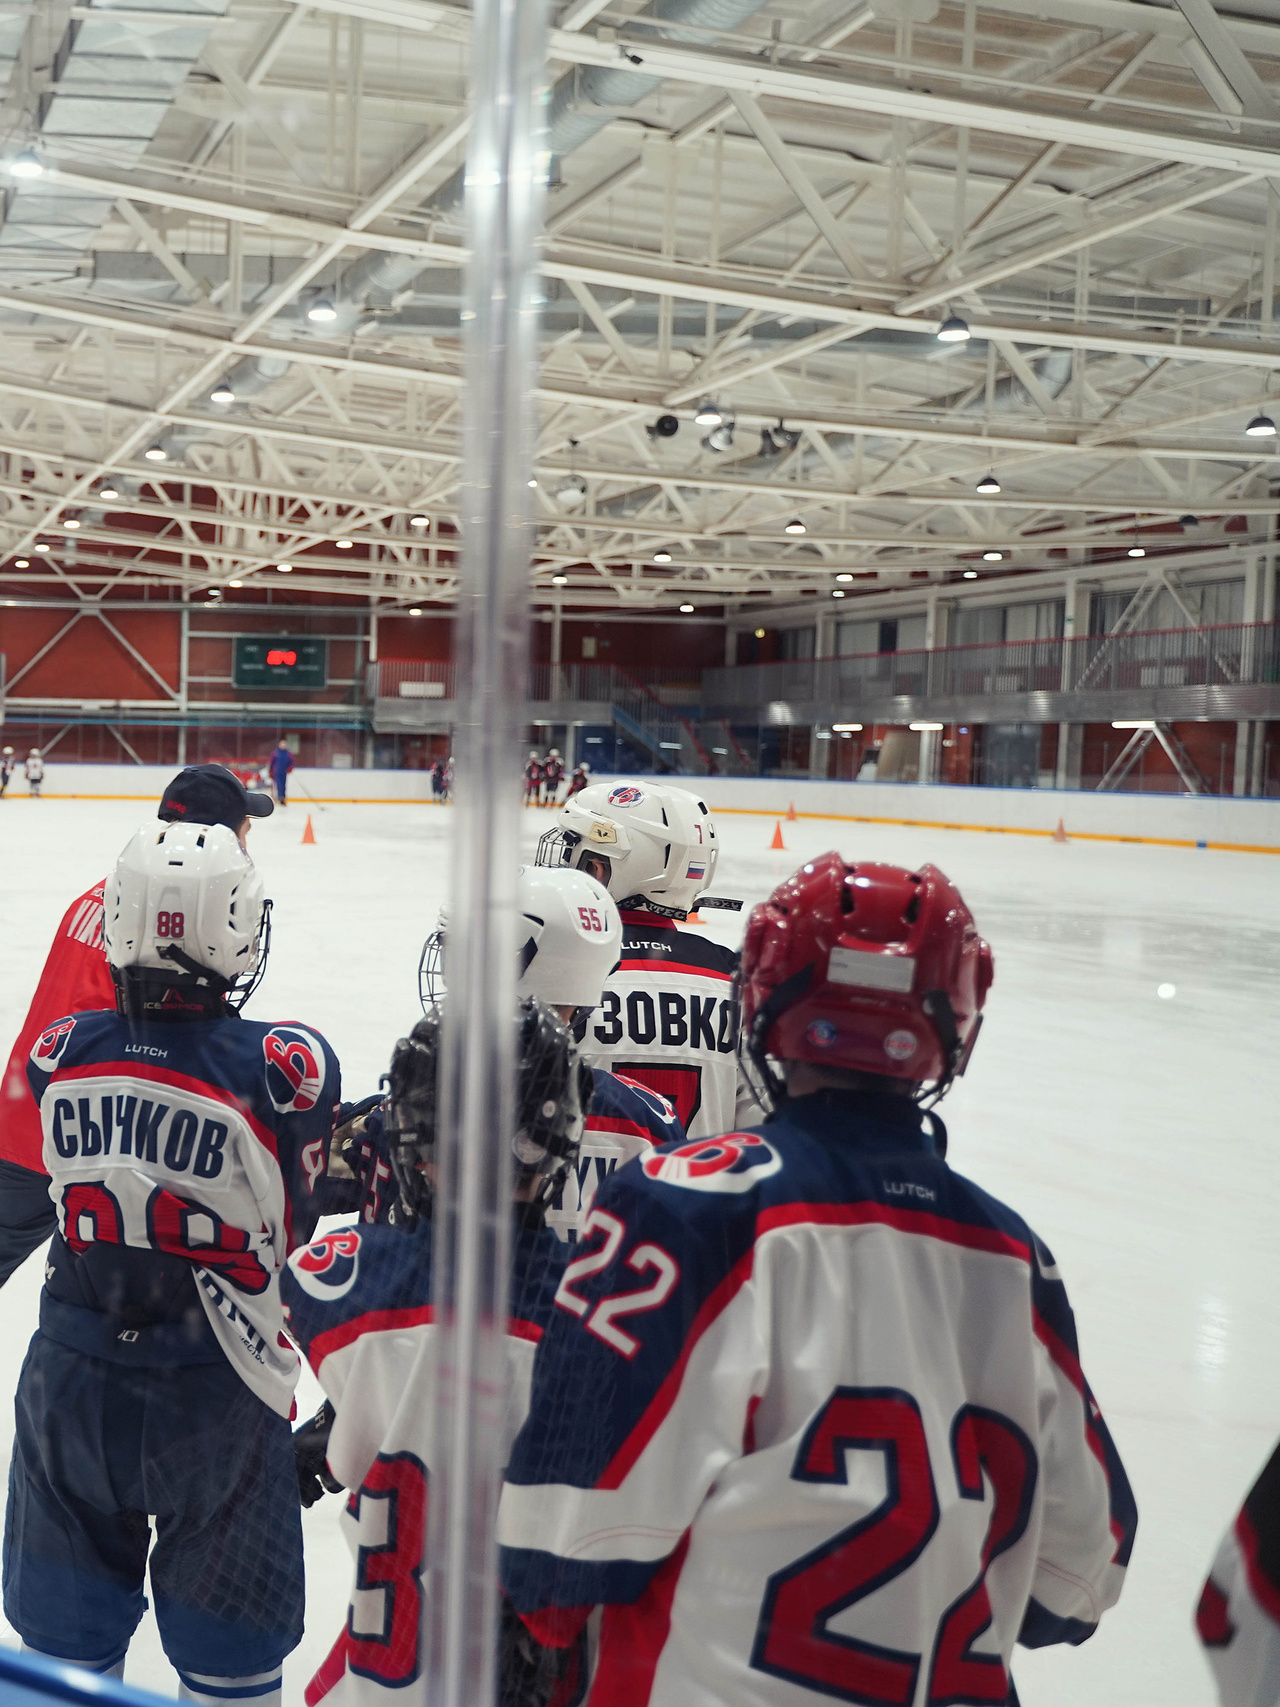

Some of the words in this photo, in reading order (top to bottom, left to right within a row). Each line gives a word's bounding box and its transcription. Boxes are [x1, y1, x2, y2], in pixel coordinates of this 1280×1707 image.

[693, 824, 703, 844] 7
[157, 911, 185, 938] 88
[578, 907, 602, 932] 55
[621, 940, 672, 953] LUTCH
[124, 1043, 169, 1059] LUTCH
[51, 1094, 229, 1180] СЫЧКОВ
[882, 1178, 937, 1202] LUTCH
[553, 1205, 681, 1361] 22
[748, 1384, 1039, 1707] 22
